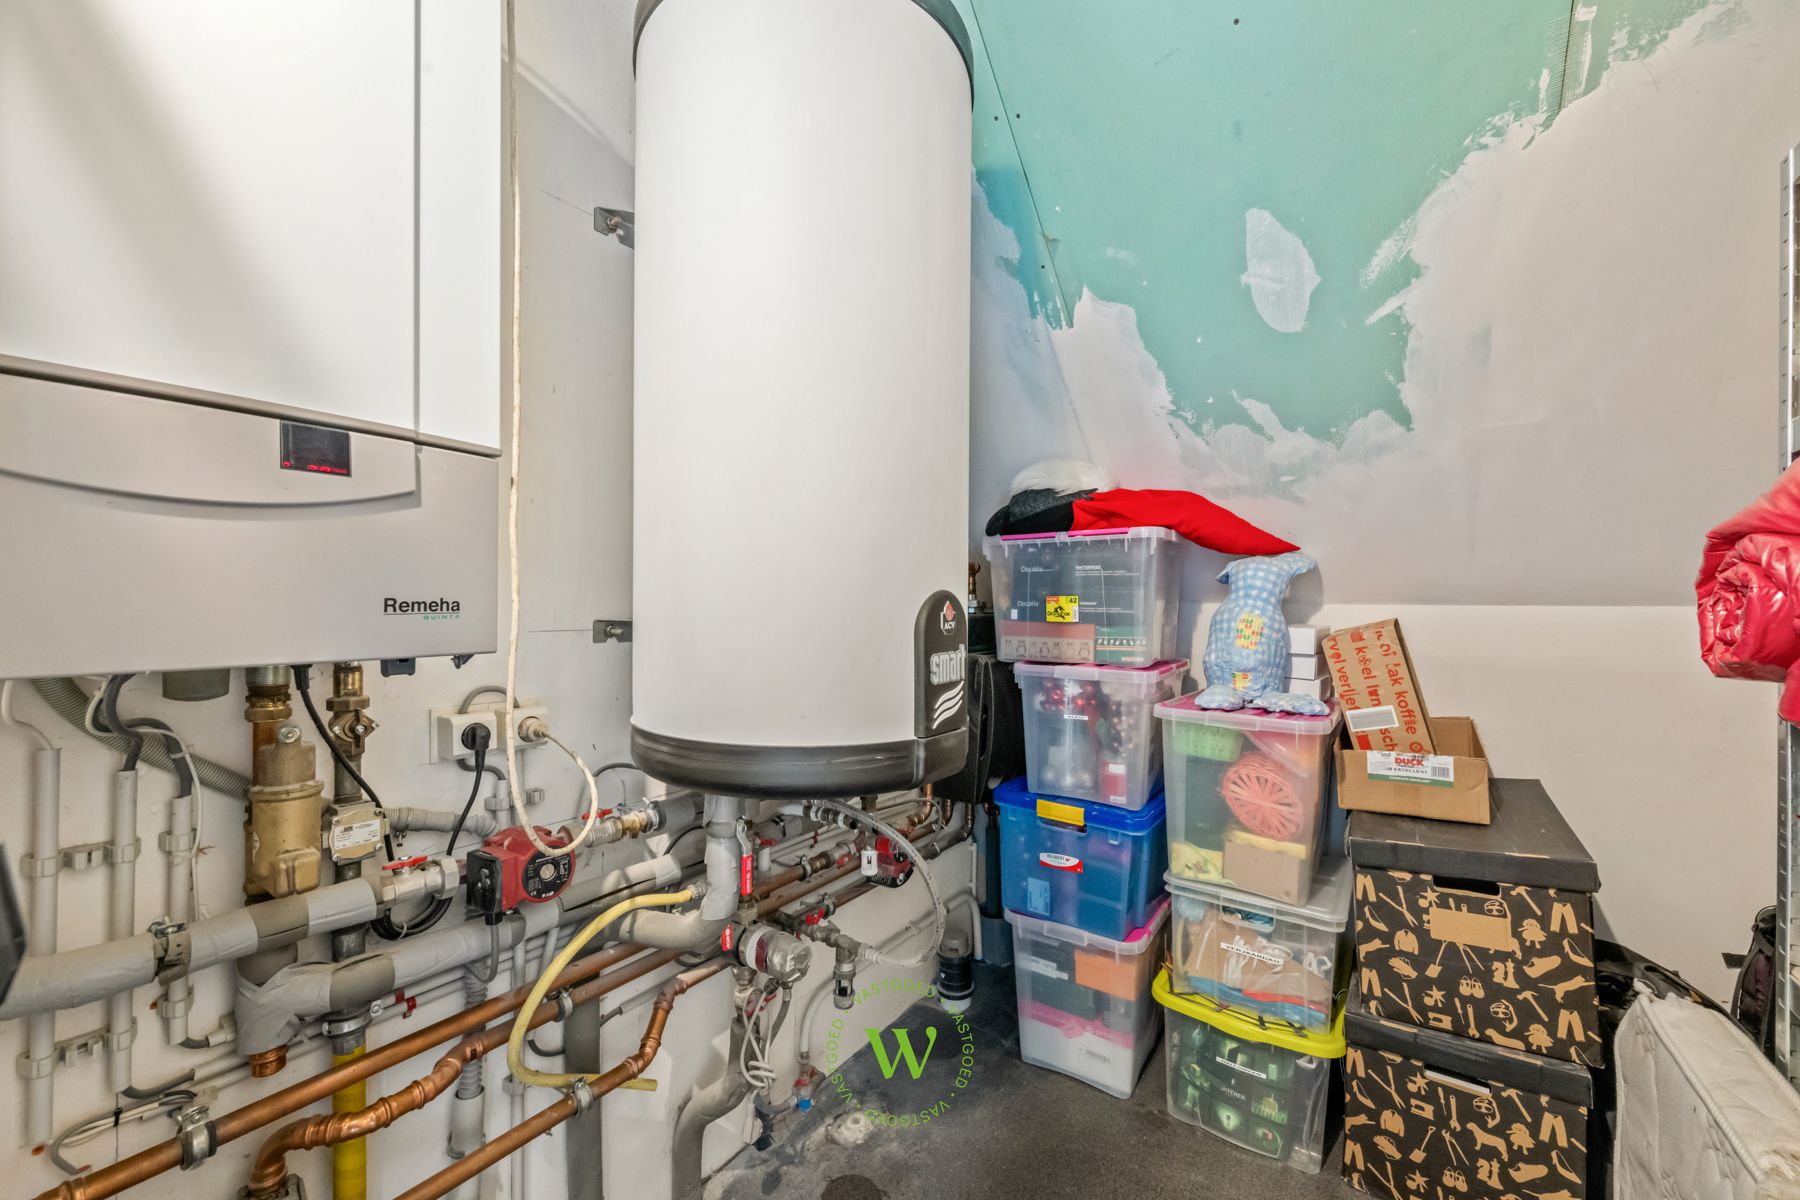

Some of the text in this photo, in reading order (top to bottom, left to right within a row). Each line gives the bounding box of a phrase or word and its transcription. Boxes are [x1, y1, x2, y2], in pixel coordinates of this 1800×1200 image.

[383, 597, 461, 613] Remeha
[944, 621, 956, 630] ACV
[930, 643, 967, 686] smart
[1394, 756, 1425, 768] DUCK
[1226, 944, 1280, 964] VERJAARDAG
